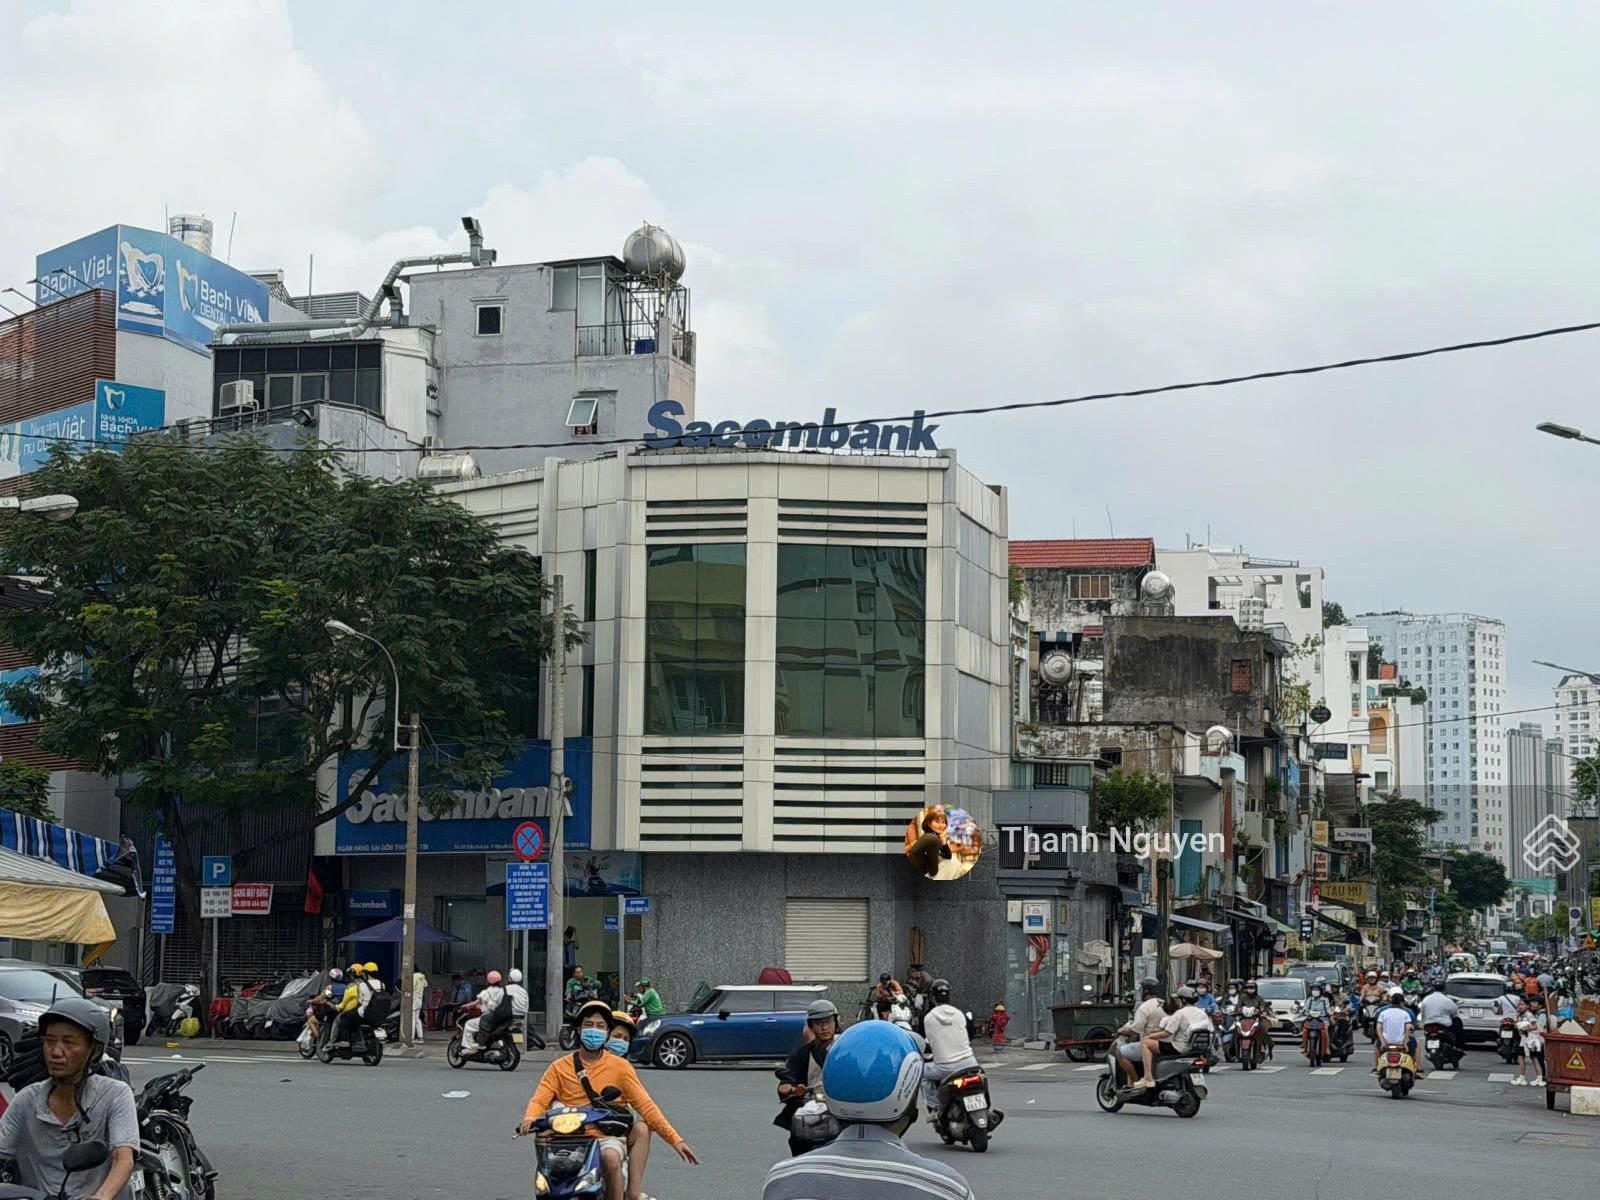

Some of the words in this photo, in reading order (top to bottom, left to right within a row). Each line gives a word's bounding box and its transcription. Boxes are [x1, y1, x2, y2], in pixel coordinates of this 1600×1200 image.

[200, 279, 232, 313] Bach
[643, 399, 940, 451] Sacombank
[212, 863, 226, 879] P
